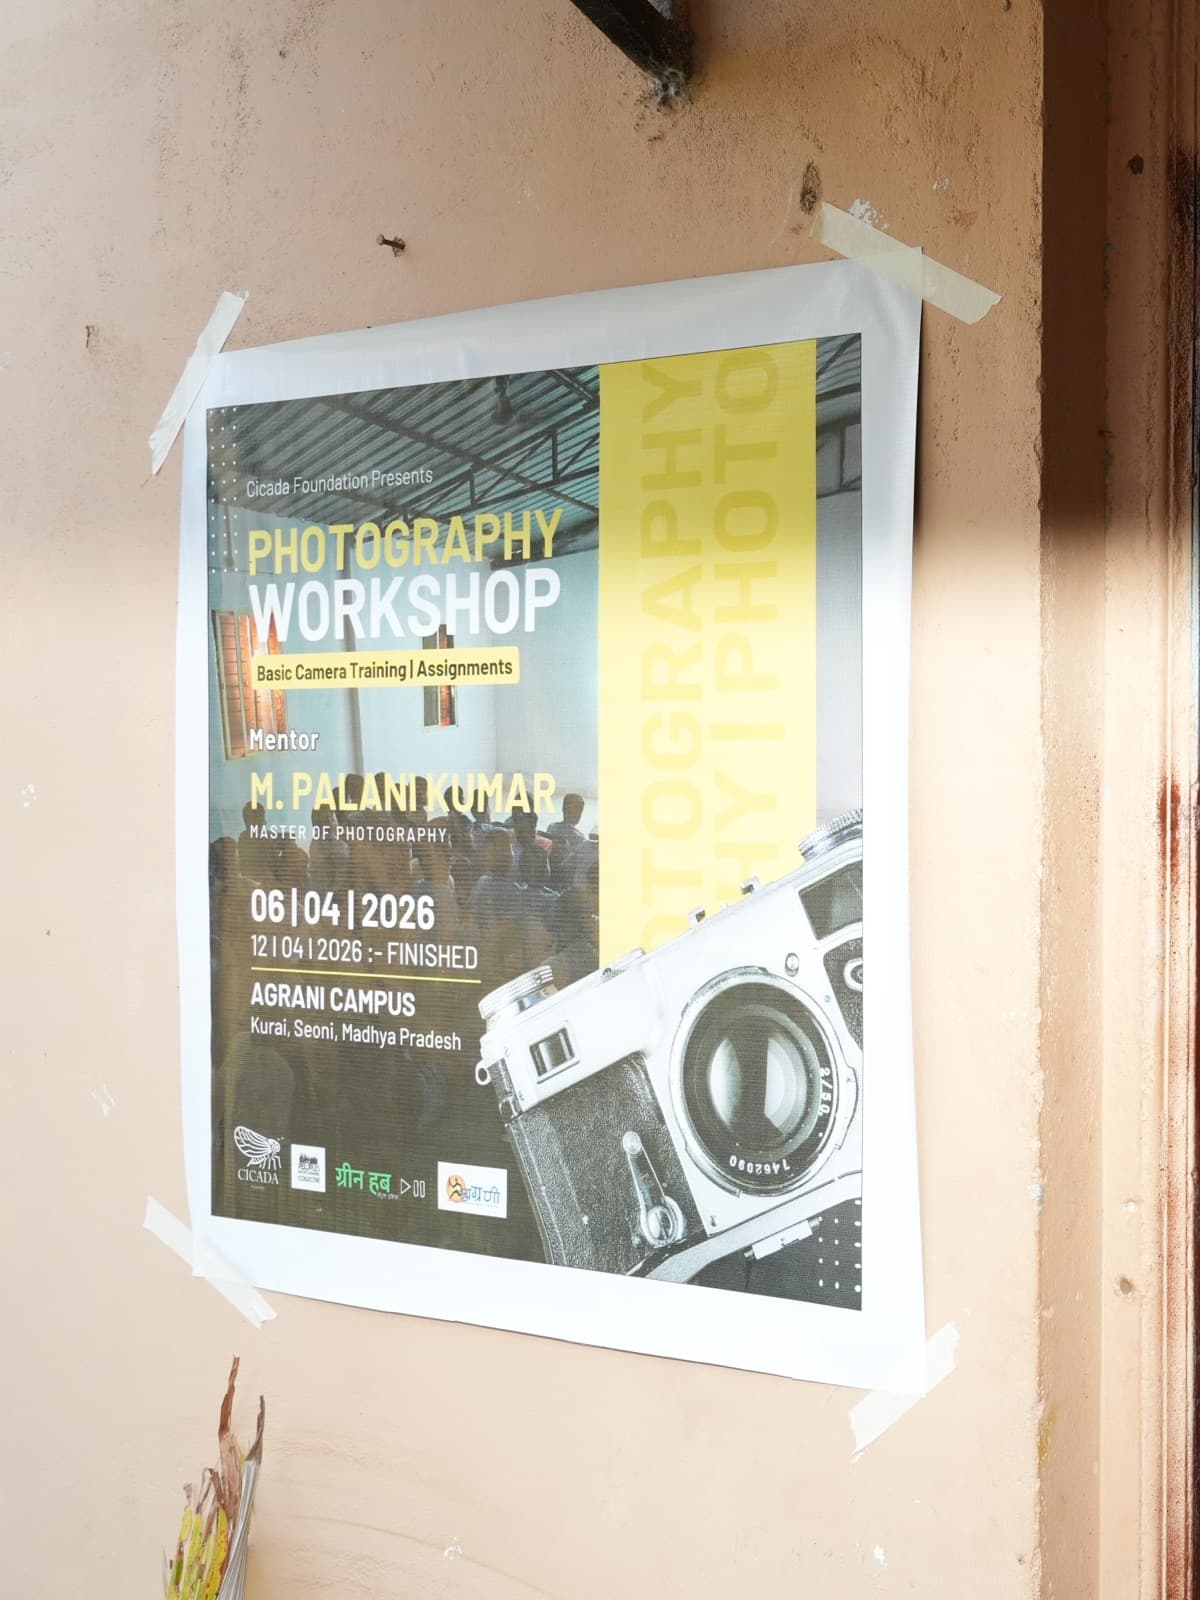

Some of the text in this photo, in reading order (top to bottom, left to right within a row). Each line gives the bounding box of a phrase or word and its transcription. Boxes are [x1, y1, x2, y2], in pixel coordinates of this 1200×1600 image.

[247, 467, 433, 497] Cicada Foundation Presents
[713, 349, 778, 692] PHOTO
[248, 508, 565, 576] PHOTOGRAPHY
[248, 567, 562, 643] WORKSHOP
[257, 665, 292, 682] Basic
[295, 664, 347, 681] Camera
[350, 661, 407, 682] Training
[417, 659, 513, 680] Assignments
[250, 728, 320, 751] Mentor
[250, 771, 557, 815] M. PALANI KUMAR
[250, 824, 447, 843] MASTER OF PHOTOGRAPHY
[387, 942, 478, 969] FINISHED
[251, 982, 416, 1016] AGRANI CAMPUS
[251, 1016, 461, 1050] Kurai, Seoni, Madhya Pradesh
[237, 1168, 279, 1184] CICADA
[335, 1162, 365, 1190] ग्रीन
[368, 1171, 393, 1196] हब
